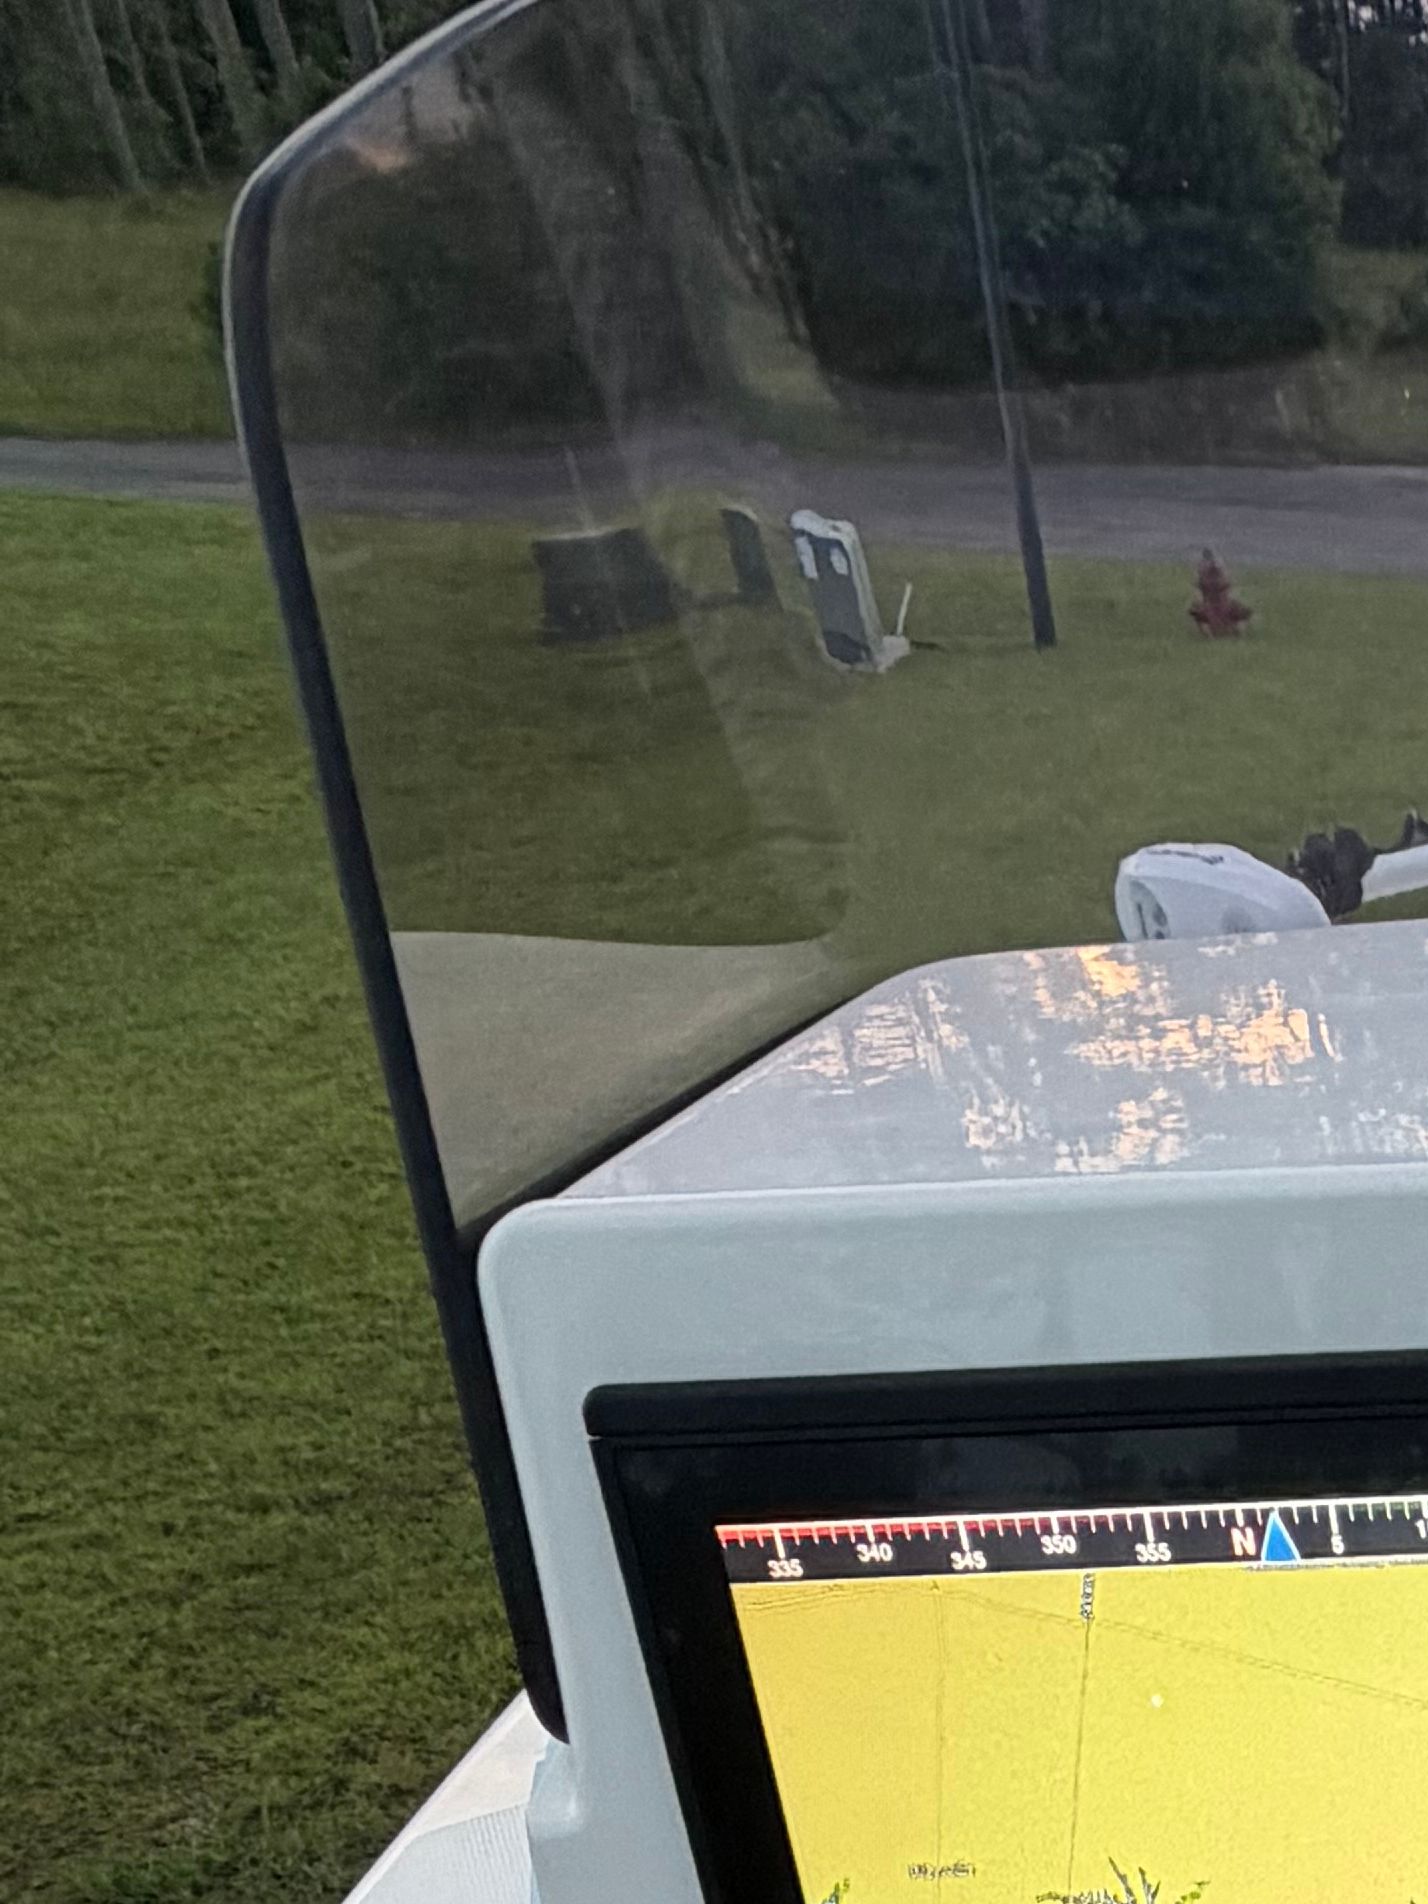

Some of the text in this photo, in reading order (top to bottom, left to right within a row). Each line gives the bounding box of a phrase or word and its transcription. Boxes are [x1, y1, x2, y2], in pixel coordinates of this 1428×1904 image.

[1040, 1534, 1078, 1555] 350
[1134, 1541, 1171, 1563] 355
[1231, 1527, 1256, 1556] N
[858, 1542, 893, 1563] 340
[951, 1550, 987, 1571] 345
[768, 1558, 803, 1579] 335
